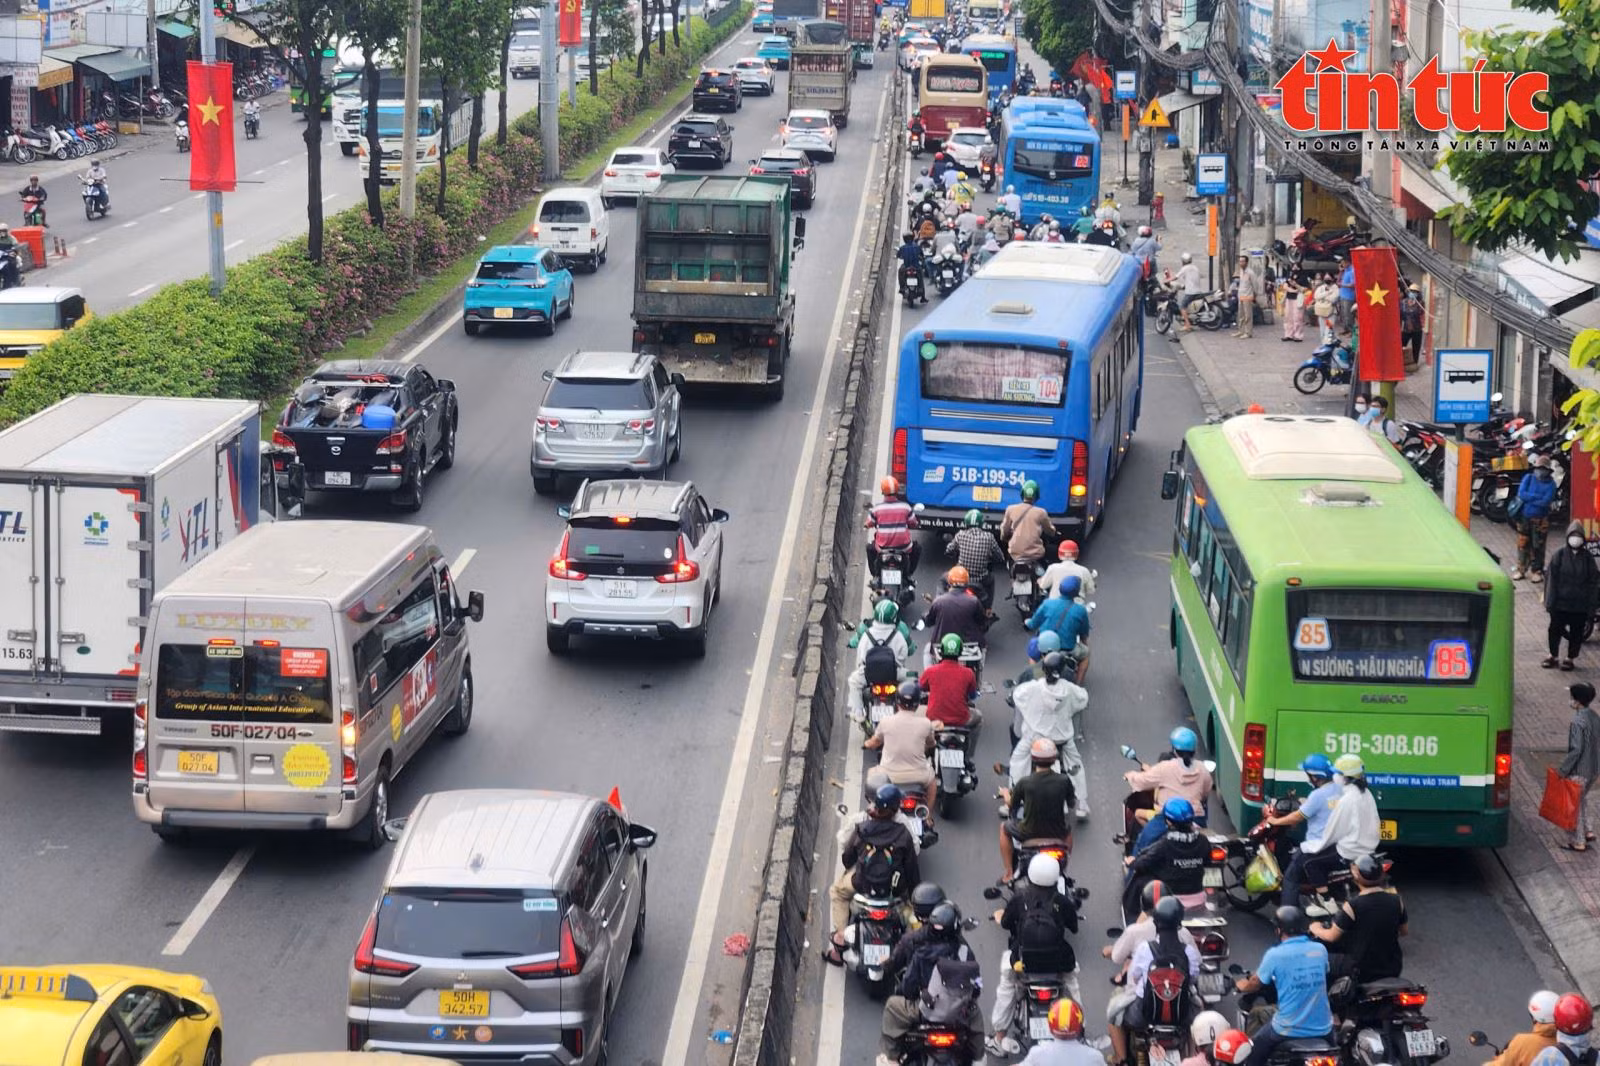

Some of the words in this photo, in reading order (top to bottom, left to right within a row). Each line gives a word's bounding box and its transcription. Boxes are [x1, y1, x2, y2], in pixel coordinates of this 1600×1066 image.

[1039, 380, 1057, 398] 104
[0, 511, 26, 534] TL
[176, 613, 312, 630] LUXURY
[1299, 622, 1326, 645] 85
[1312, 655, 1354, 677] SƯƠNG
[1387, 655, 1425, 678] NGHĨA
[1437, 646, 1467, 677] 85
[175, 702, 197, 711] Group
[199, 703, 207, 711] of
[207, 703, 228, 711] Asian
[278, 705, 314, 713] Education
[1325, 733, 1438, 756] 51B-308.06
[1397, 777, 1409, 785] KHI
[1411, 777, 1421, 786] RA
[453, 991, 476, 1002] 50H
[444, 1003, 484, 1015] 342.57
